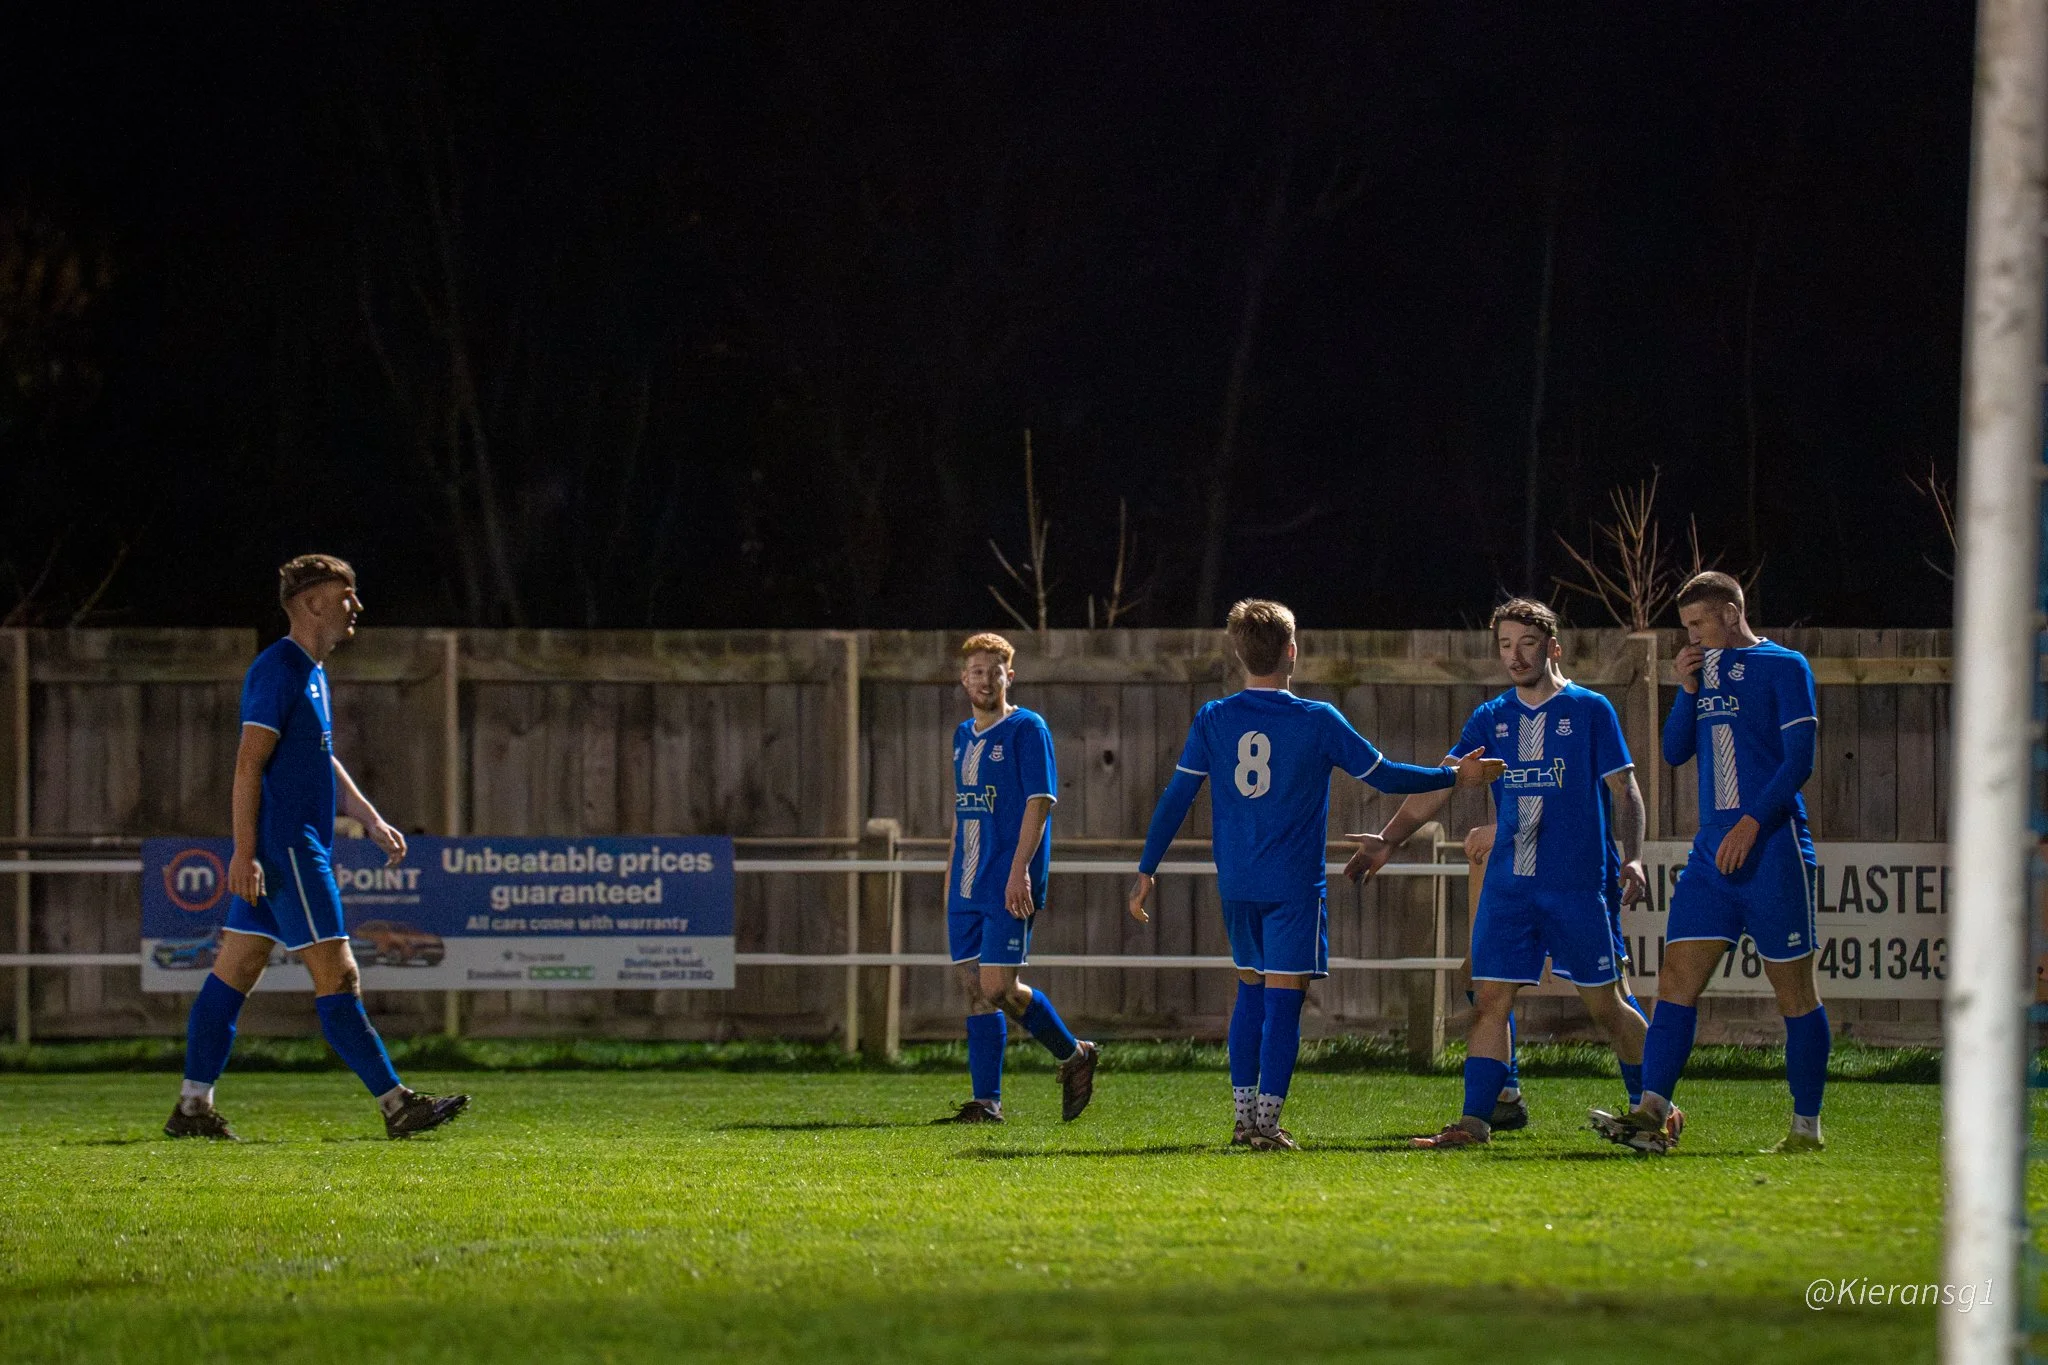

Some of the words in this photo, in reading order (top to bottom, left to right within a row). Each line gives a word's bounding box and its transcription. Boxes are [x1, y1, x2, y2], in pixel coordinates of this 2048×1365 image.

[1234, 731, 1271, 799] 8
[441, 846, 613, 873] Unbeatable
[619, 846, 714, 877] prices
[490, 878, 664, 911] guaranteed
[466, 915, 490, 930] All
[491, 917, 526, 931] cars
[530, 917, 574, 930] come
[577, 915, 613, 930] with
[616, 916, 689, 932] warranty
